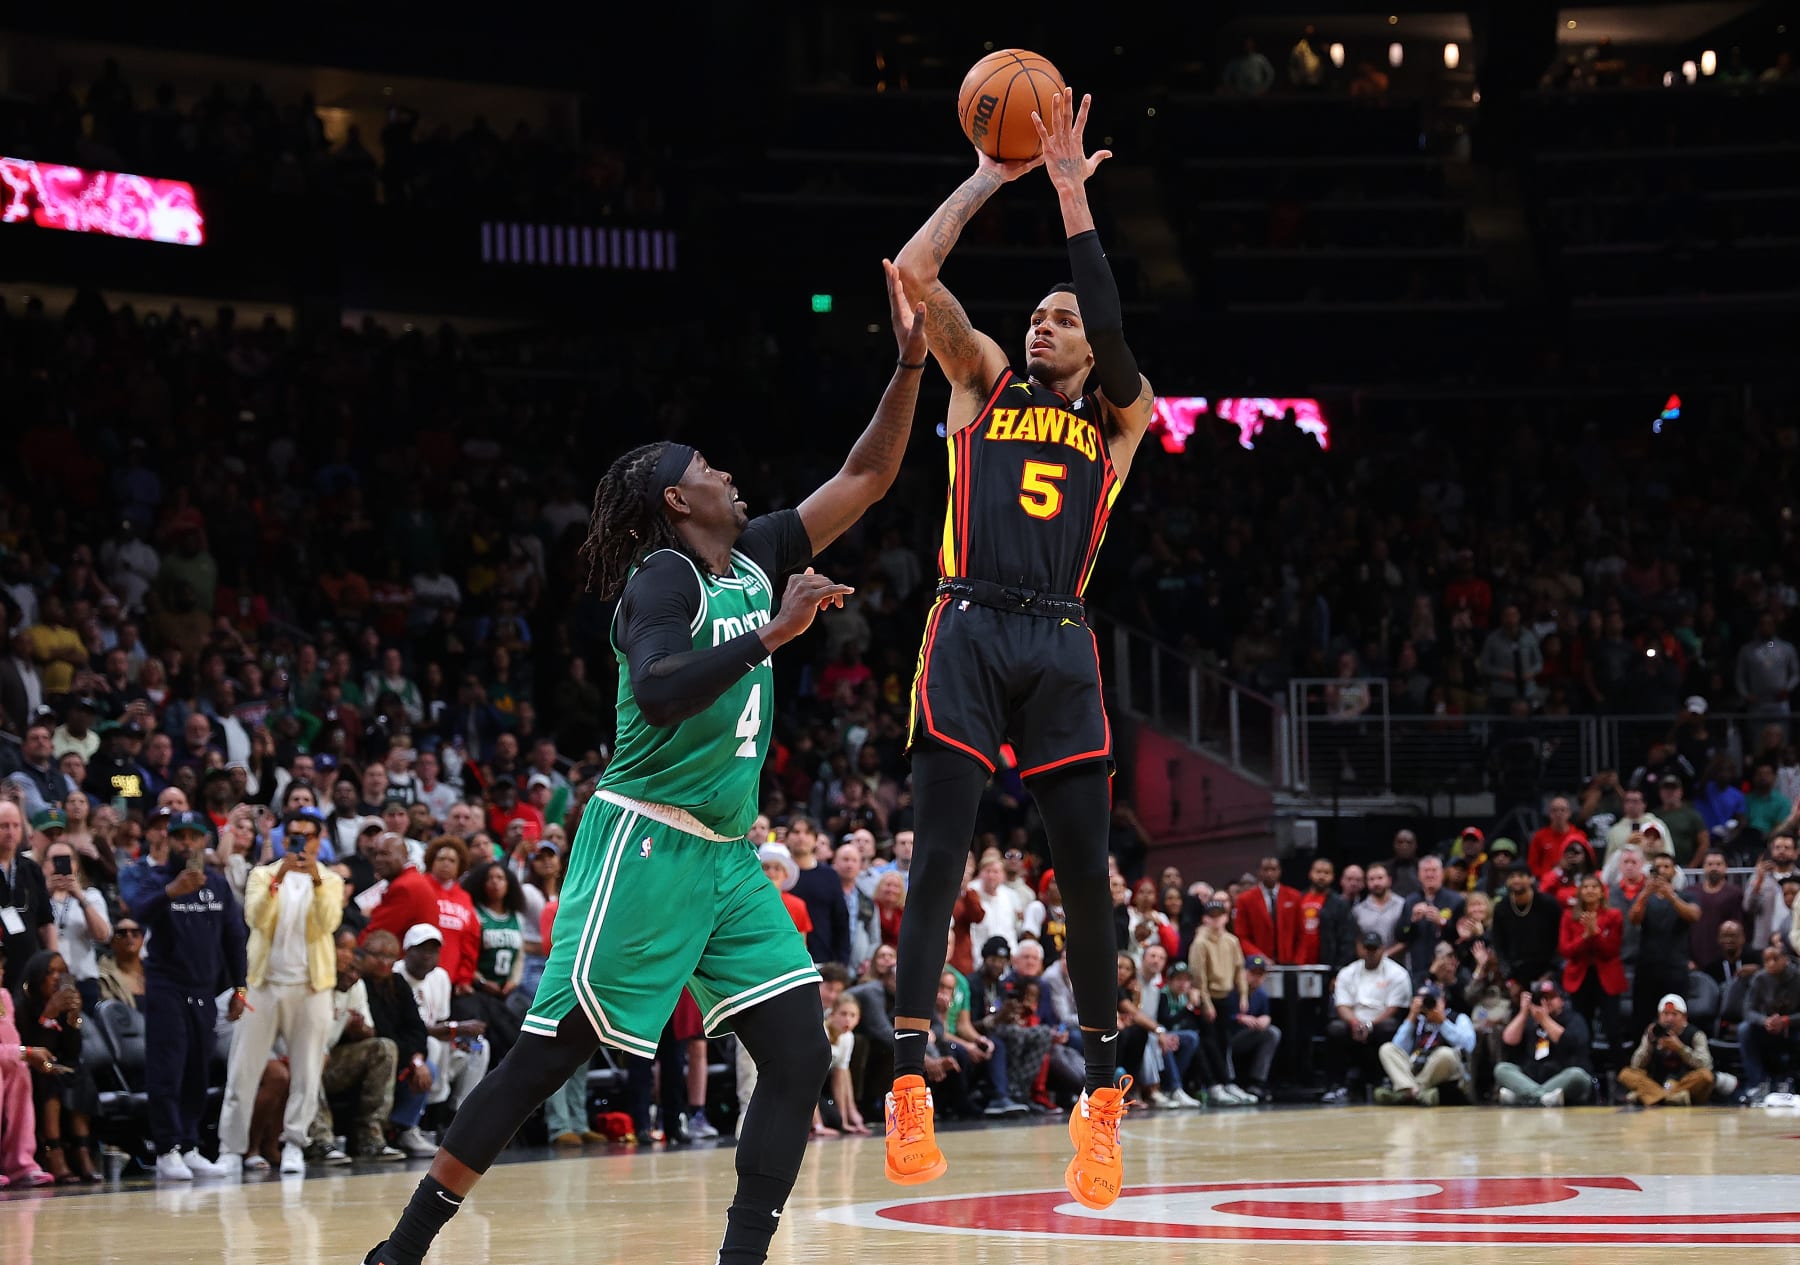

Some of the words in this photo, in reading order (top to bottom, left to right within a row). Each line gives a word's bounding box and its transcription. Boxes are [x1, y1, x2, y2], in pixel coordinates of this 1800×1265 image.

[985, 406, 1097, 462] HAWKS
[1019, 459, 1068, 521] 5
[735, 683, 761, 757] 4
